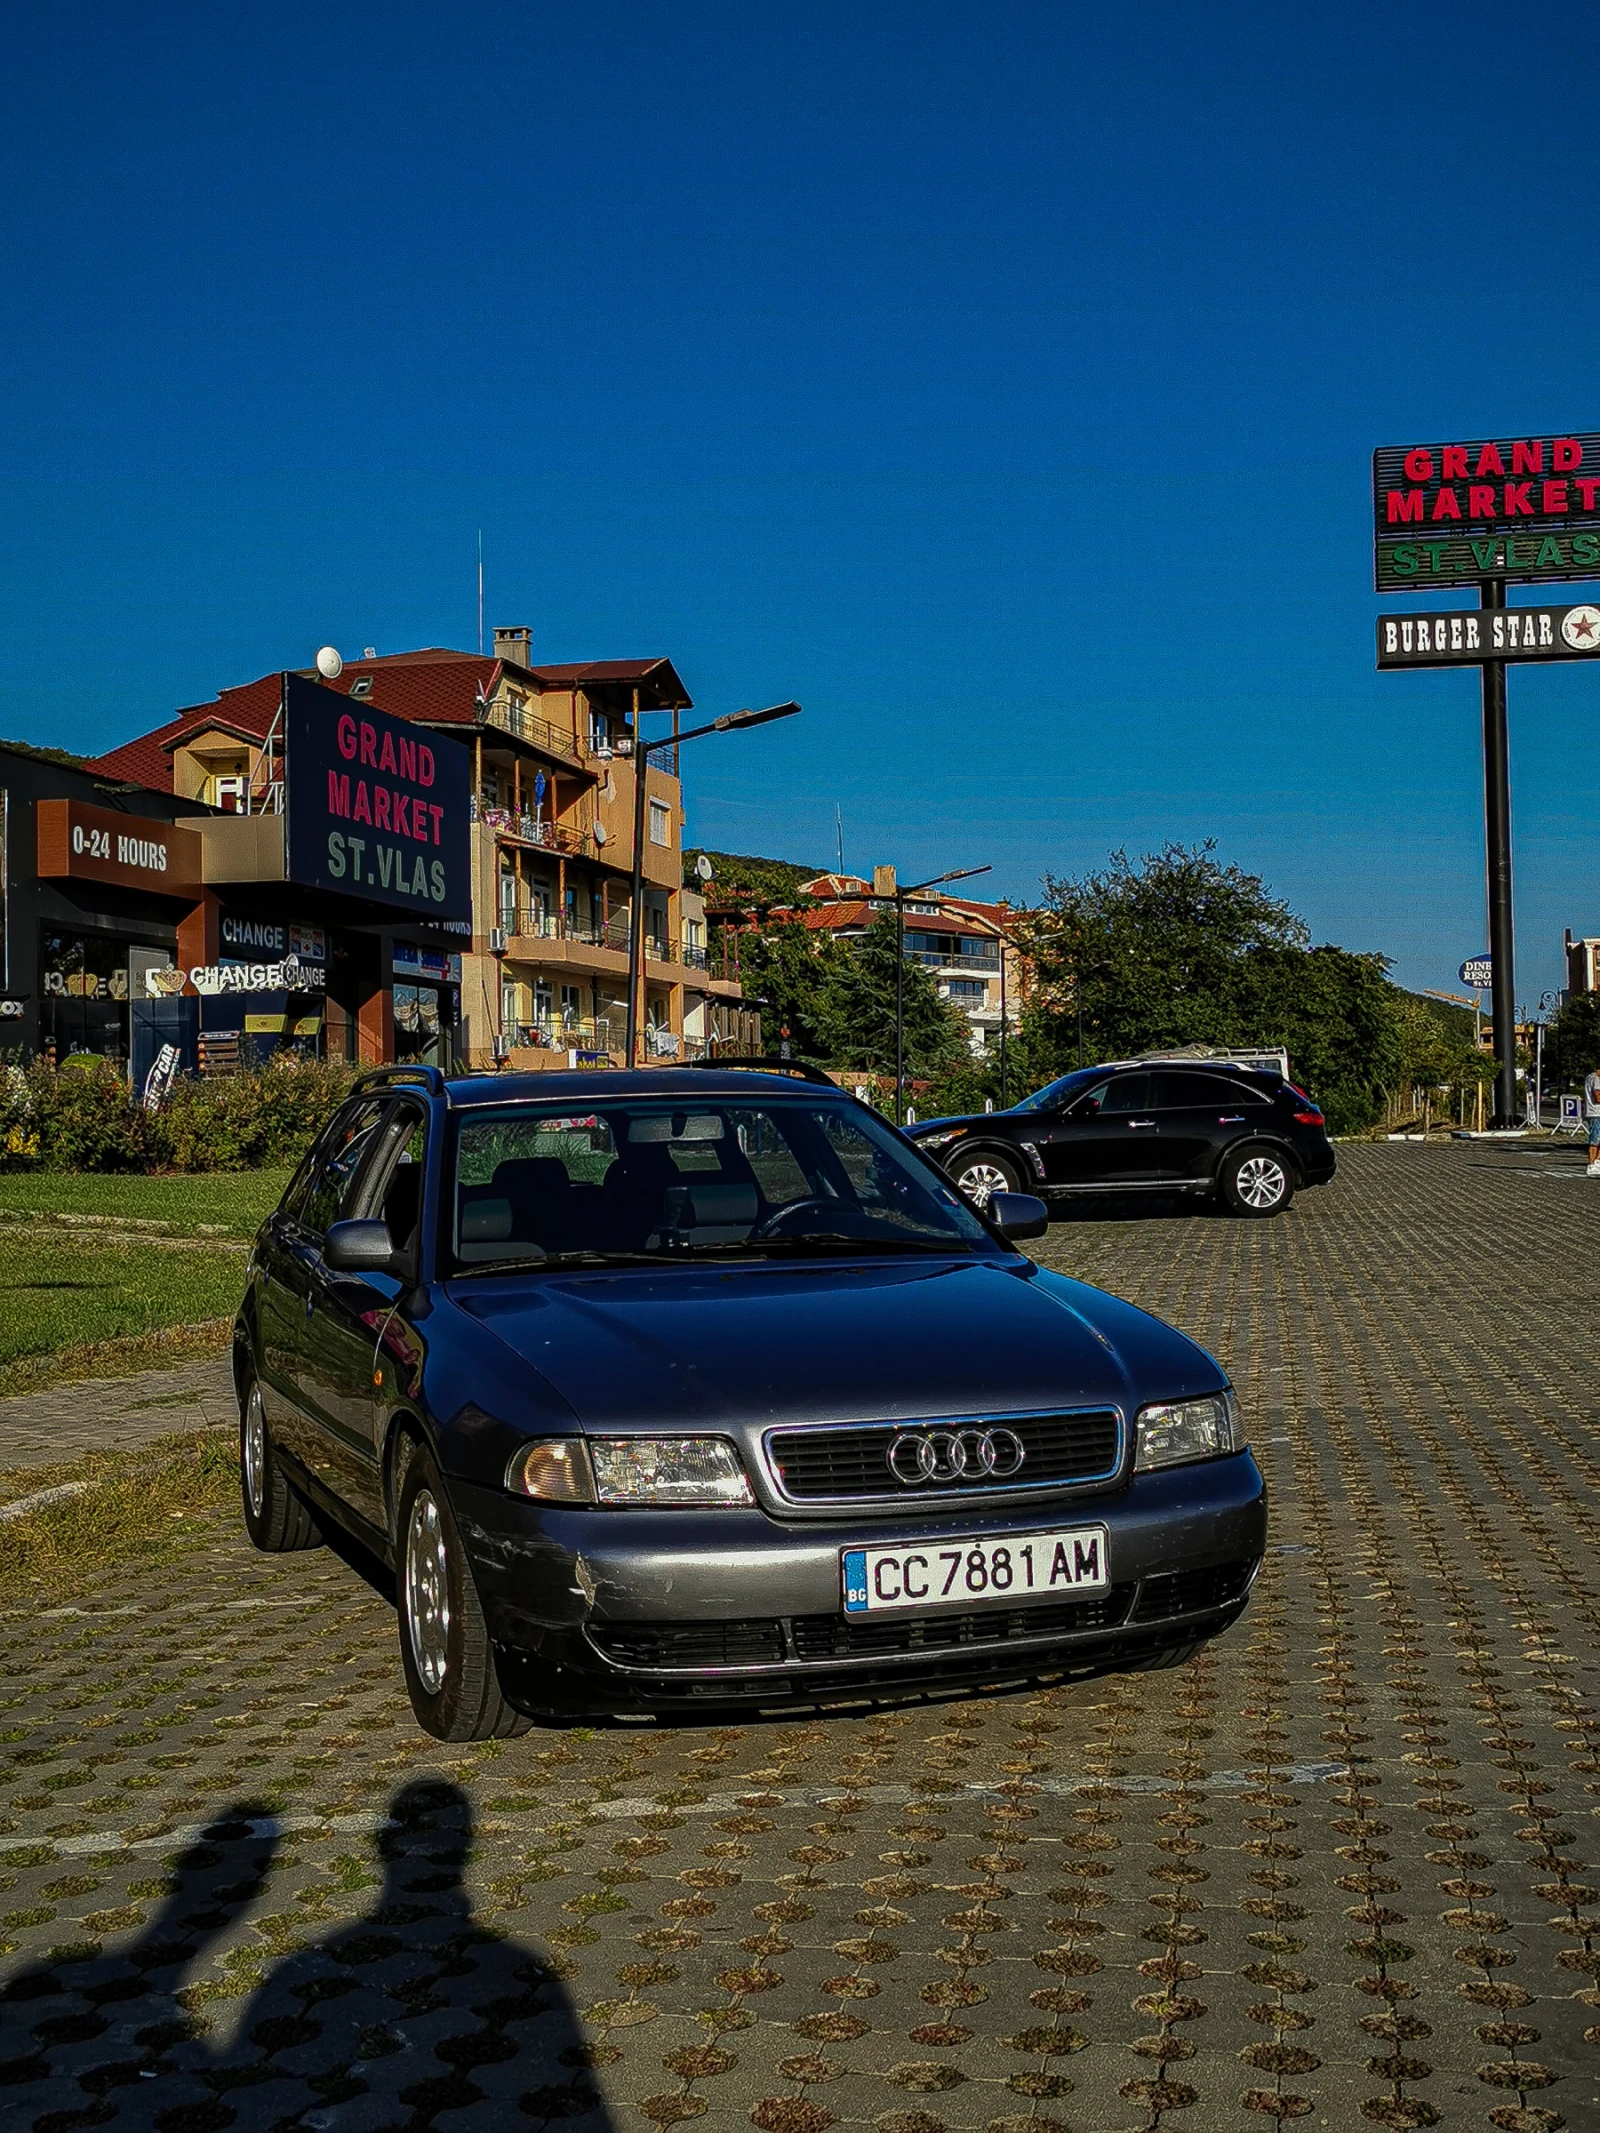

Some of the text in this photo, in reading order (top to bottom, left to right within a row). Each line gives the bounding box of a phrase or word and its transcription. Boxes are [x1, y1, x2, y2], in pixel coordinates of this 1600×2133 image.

[1403, 439, 1584, 481] GRAND
[1387, 478, 1600, 522] MARKET
[1393, 534, 1600, 576] ST.VLAS
[1385, 617, 1480, 653] BURGER
[1492, 614, 1553, 648] STAR
[337, 714, 435, 787] GRAND
[328, 770, 444, 845] MARKET
[73, 825, 167, 872] 0-24 HOURS
[328, 831, 445, 902] ST.VLAS
[222, 917, 284, 949] CHANGE
[190, 964, 280, 986] CHANGE
[286, 965, 326, 986] CHANGE
[1463, 971, 1492, 980] RESO
[1466, 961, 1492, 971] DINE
[0, 1001, 24, 1015] OX
[157, 1043, 175, 1074] CAR
[1566, 1100, 1575, 1115] P
[874, 1538, 1099, 1601] CC 7881 AM
[848, 1588, 866, 1602] BG
